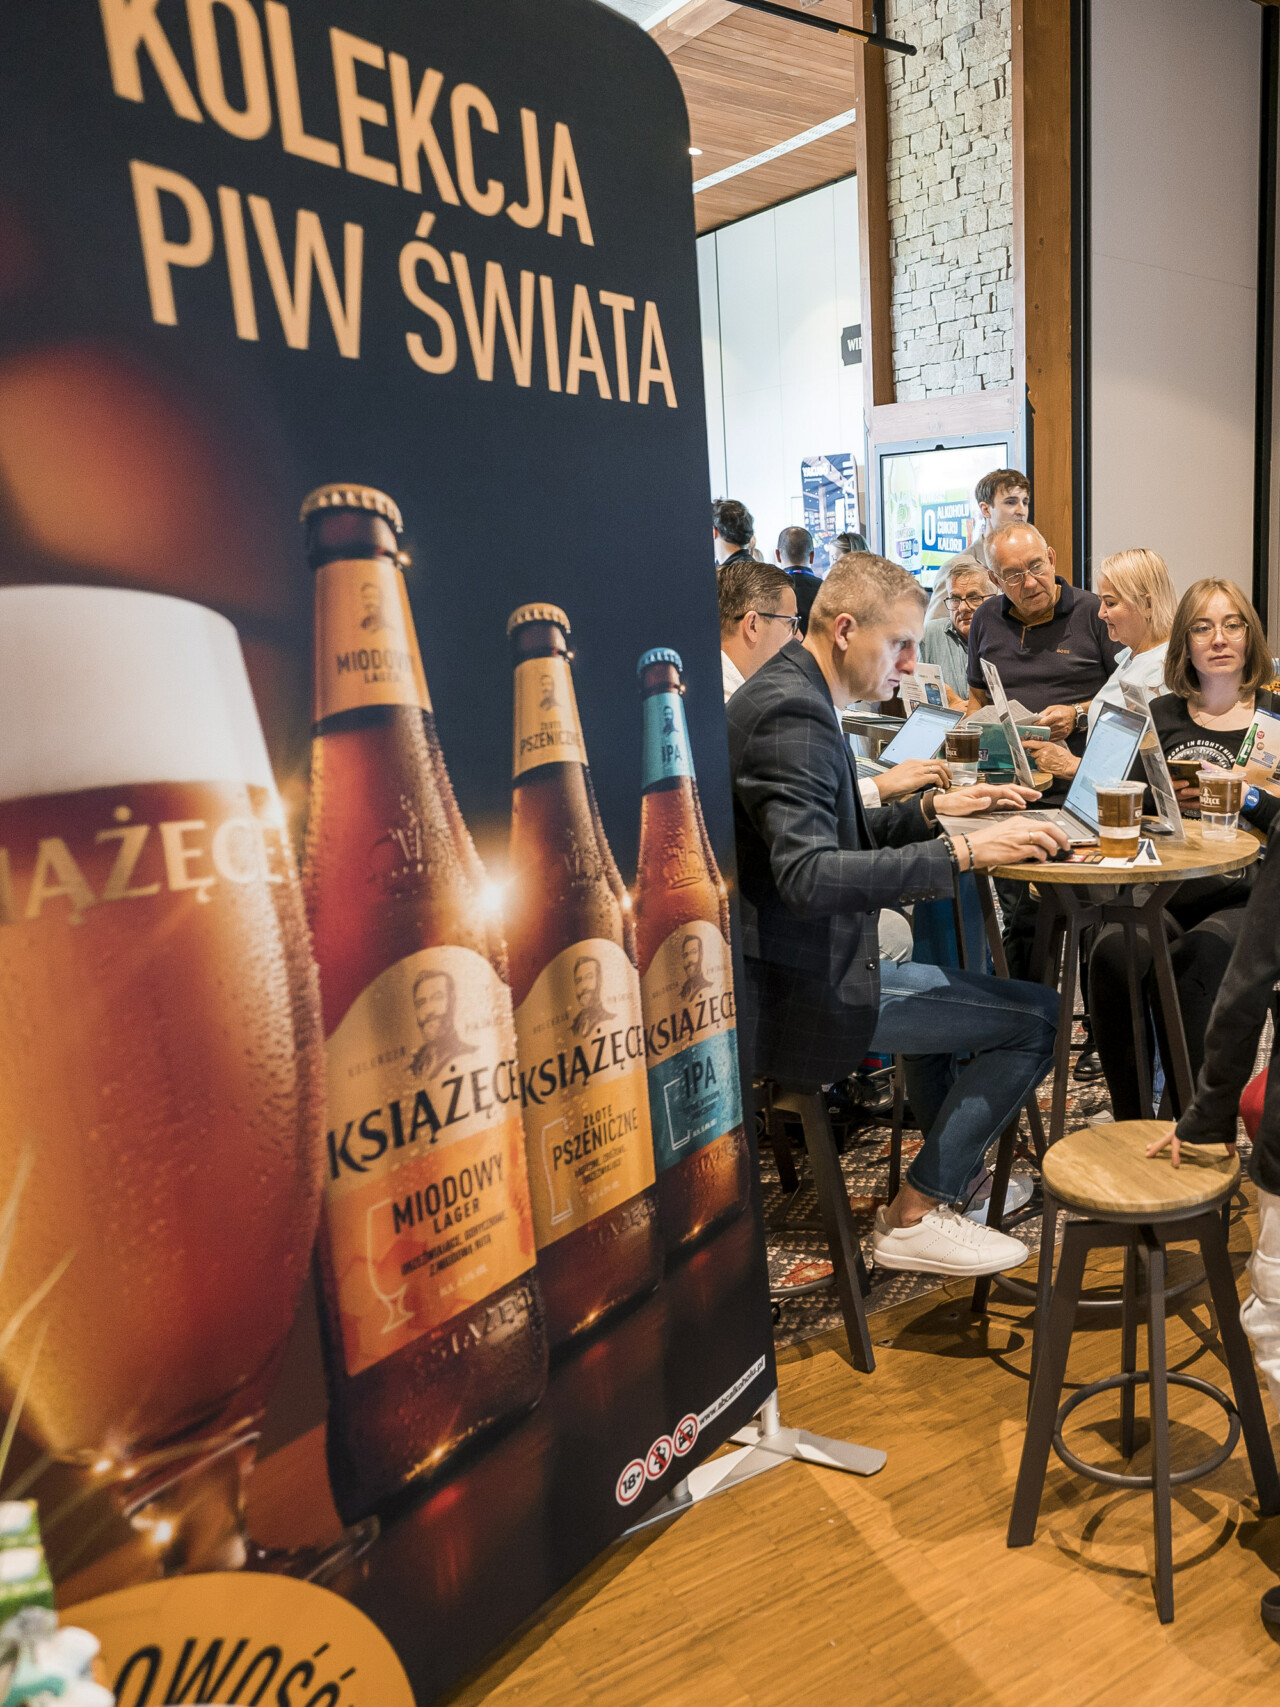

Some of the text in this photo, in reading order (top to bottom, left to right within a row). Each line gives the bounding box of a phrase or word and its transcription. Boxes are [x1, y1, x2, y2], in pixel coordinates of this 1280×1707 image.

[98, 0, 594, 246] KOLEKCJA
[129, 159, 678, 409] PIW ŚWIATA
[661, 745, 682, 762] IPA
[1197, 740, 1224, 751] EIGHTY
[644, 991, 736, 1058] KSIĄŻĘCE
[519, 1025, 643, 1108] KSIĄŻĘCE
[683, 1055, 717, 1099] IPA
[327, 1060, 520, 1181] KSIĄŻĘCE
[553, 1107, 638, 1172] PSZENICZNE
[583, 1104, 612, 1129] ZŁOTE
[392, 1151, 503, 1235] MIODOWY
[432, 1198, 480, 1235] LAGER
[621, 1471, 642, 1494] 18+
